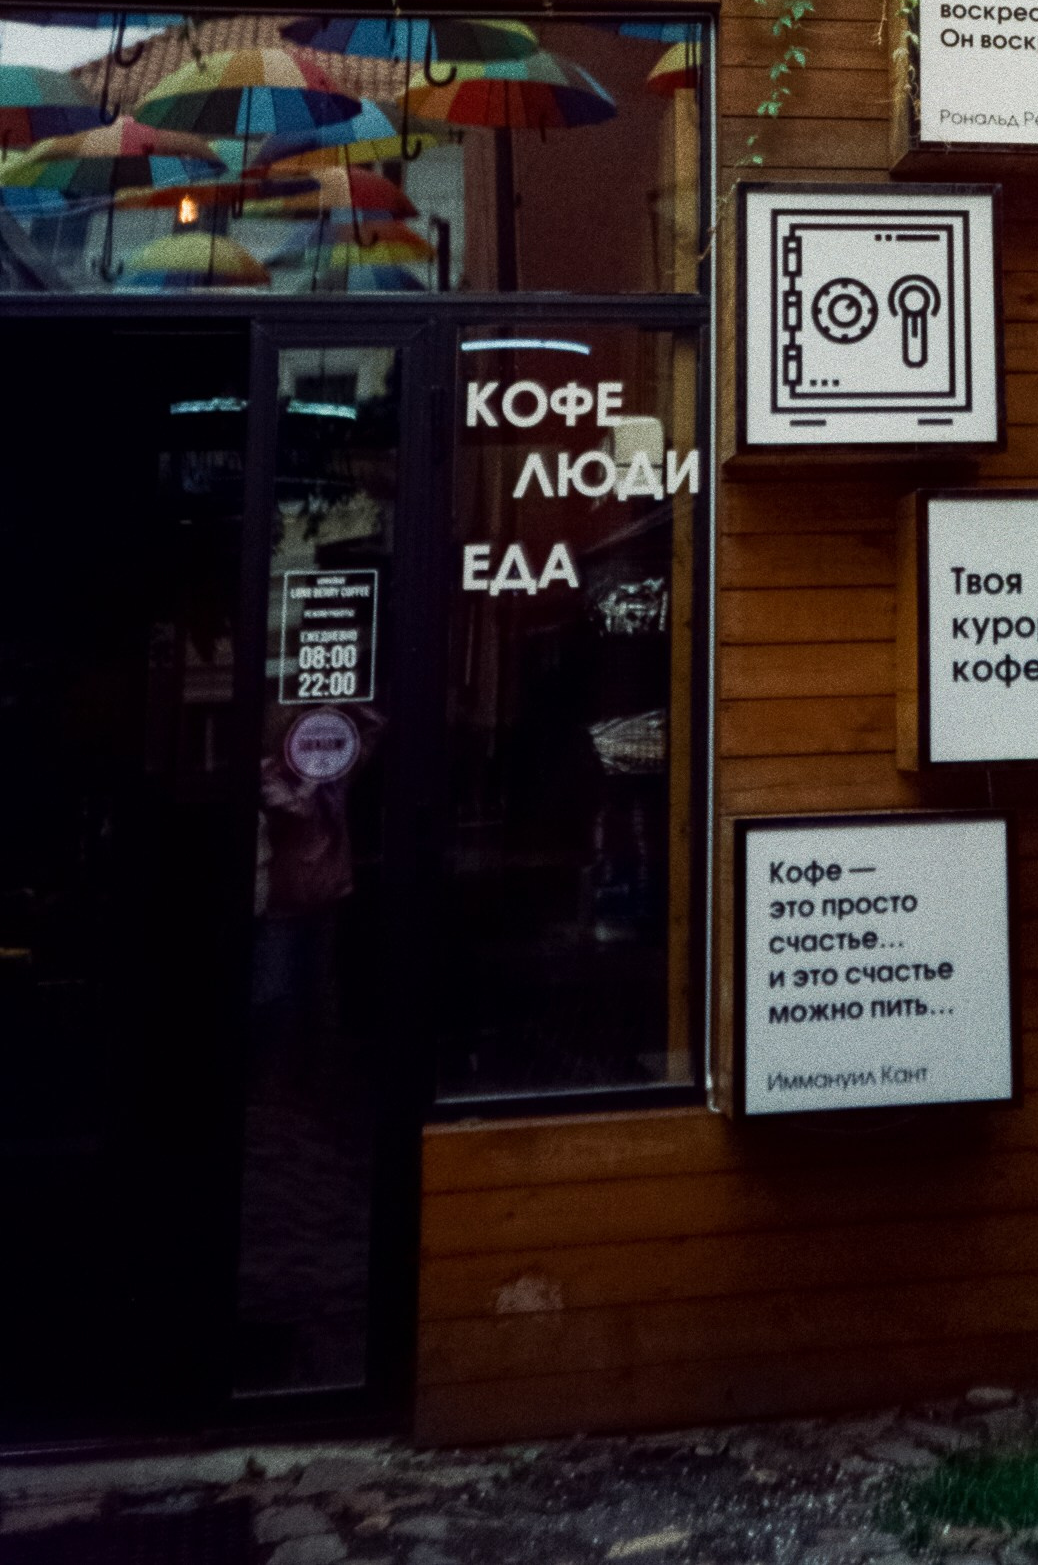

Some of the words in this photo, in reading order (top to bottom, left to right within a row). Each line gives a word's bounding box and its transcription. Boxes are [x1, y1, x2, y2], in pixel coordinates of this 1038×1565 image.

[939, 28, 974, 48] Он
[939, 108, 1020, 128] Рональд
[466, 380, 624, 428] КОФЕ
[512, 448, 700, 502] ЛЮДИ
[462, 542, 579, 597] ЕДА
[950, 566, 1023, 595] Твоя
[298, 644, 358, 670] 08:00
[297, 671, 357, 698] 22:00
[769, 860, 843, 887] Кофе
[770, 899, 815, 920] это
[821, 894, 918, 921] просто
[768, 930, 905, 955] счастье...
[768, 970, 785, 989] и
[793, 967, 839, 988] это
[845, 961, 954, 985] счастье
[768, 1001, 864, 1024] можно
[870, 998, 953, 1018] пить...
[767, 1071, 876, 1092] Иммануил
[880, 1066, 928, 1084] Кант
